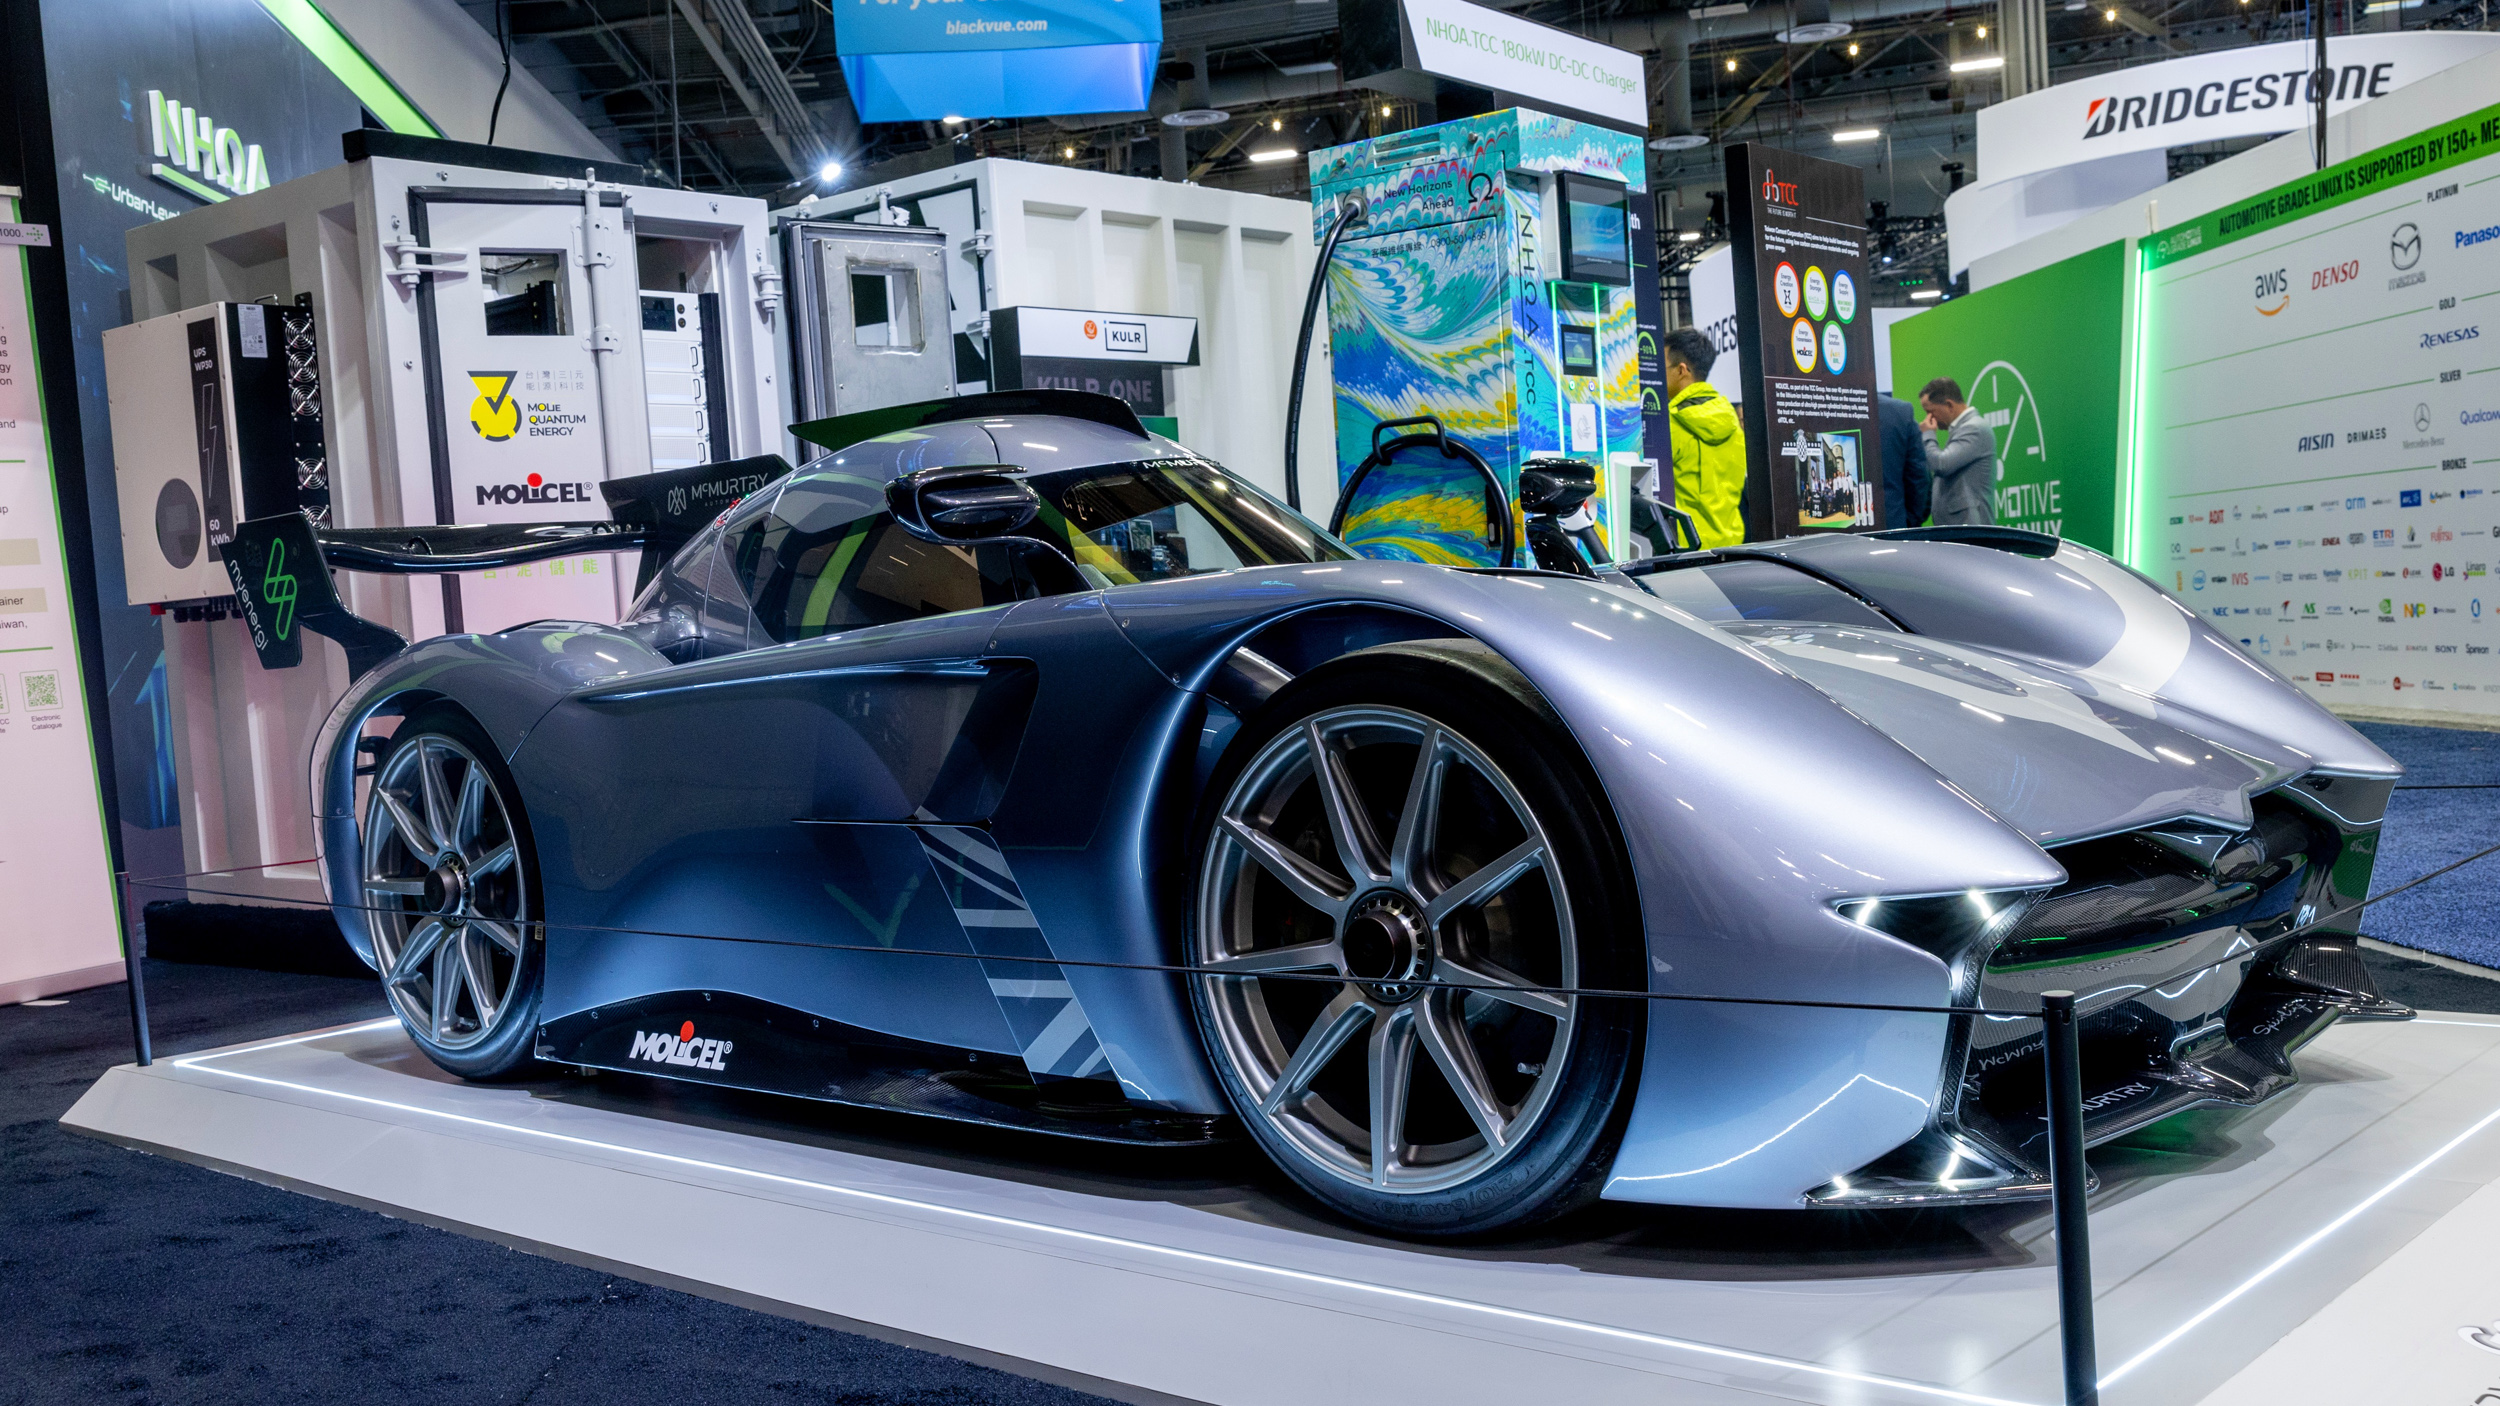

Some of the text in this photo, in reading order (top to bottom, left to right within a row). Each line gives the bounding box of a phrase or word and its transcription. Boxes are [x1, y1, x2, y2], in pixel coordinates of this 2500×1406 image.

[945, 19, 1048, 35] blackvue.com
[1501, 39, 1545, 67] 180kW
[1549, 53, 1590, 80] DC-DC
[1592, 66, 1637, 94] Charger
[2082, 63, 2394, 139] BRIDGESTONE
[2219, 197, 2276, 236] AUTOMOTIVE
[2278, 185, 2311, 214] GRADE
[2312, 176, 2343, 202] LINUX
[2345, 169, 2356, 191] IS
[2358, 145, 2426, 187] SUPPORTED
[2429, 138, 2446, 163] BY
[2447, 125, 2477, 155] 150+
[1384, 180, 1453, 199] New Horizons
[1778, 182, 1799, 206] TCC
[2427, 184, 2459, 203] PLATINUM
[1422, 197, 1454, 211] Ahead
[2311, 259, 2359, 290] DENSO
[2255, 268, 2288, 299] aws
[2438, 297, 2456, 310] GOLD
[1112, 331, 1141, 343] KULR
[2420, 325, 2480, 349] RENESAS
[193, 347, 206, 358] UPS
[194, 360, 213, 371] WP30
[2439, 369, 2461, 383] SILVER
[1109, 379, 1152, 403] ONE
[529, 414, 586, 425] QUANTUM
[530, 427, 574, 436] ENERGY
[2298, 433, 2335, 452] AISIN
[2402, 436, 2445, 449] Mercedes-Benz
[2442, 458, 2467, 470] BRONZE
[691, 473, 768, 500] McMURTRY
[2345, 497, 2366, 510] arm
[209, 519, 220, 531] 60
[210, 533, 230, 546] kWh
[2373, 529, 2394, 540] ETRI
[2430, 526, 2453, 543] FUJITSU
[2322, 537, 2341, 546] ENEA
[2444, 567, 2454, 577] LG
[2466, 561, 2486, 571] Linaro
[229, 559, 269, 651] myenergi
[2404, 603, 2426, 618] NXP
[2212, 607, 2229, 617] NEC
[0, 619, 28, 630] iwan,
[2435, 645, 2458, 653] SONY
[31, 714, 61, 723] Electronic
[32, 721, 63, 732] Catalogue
